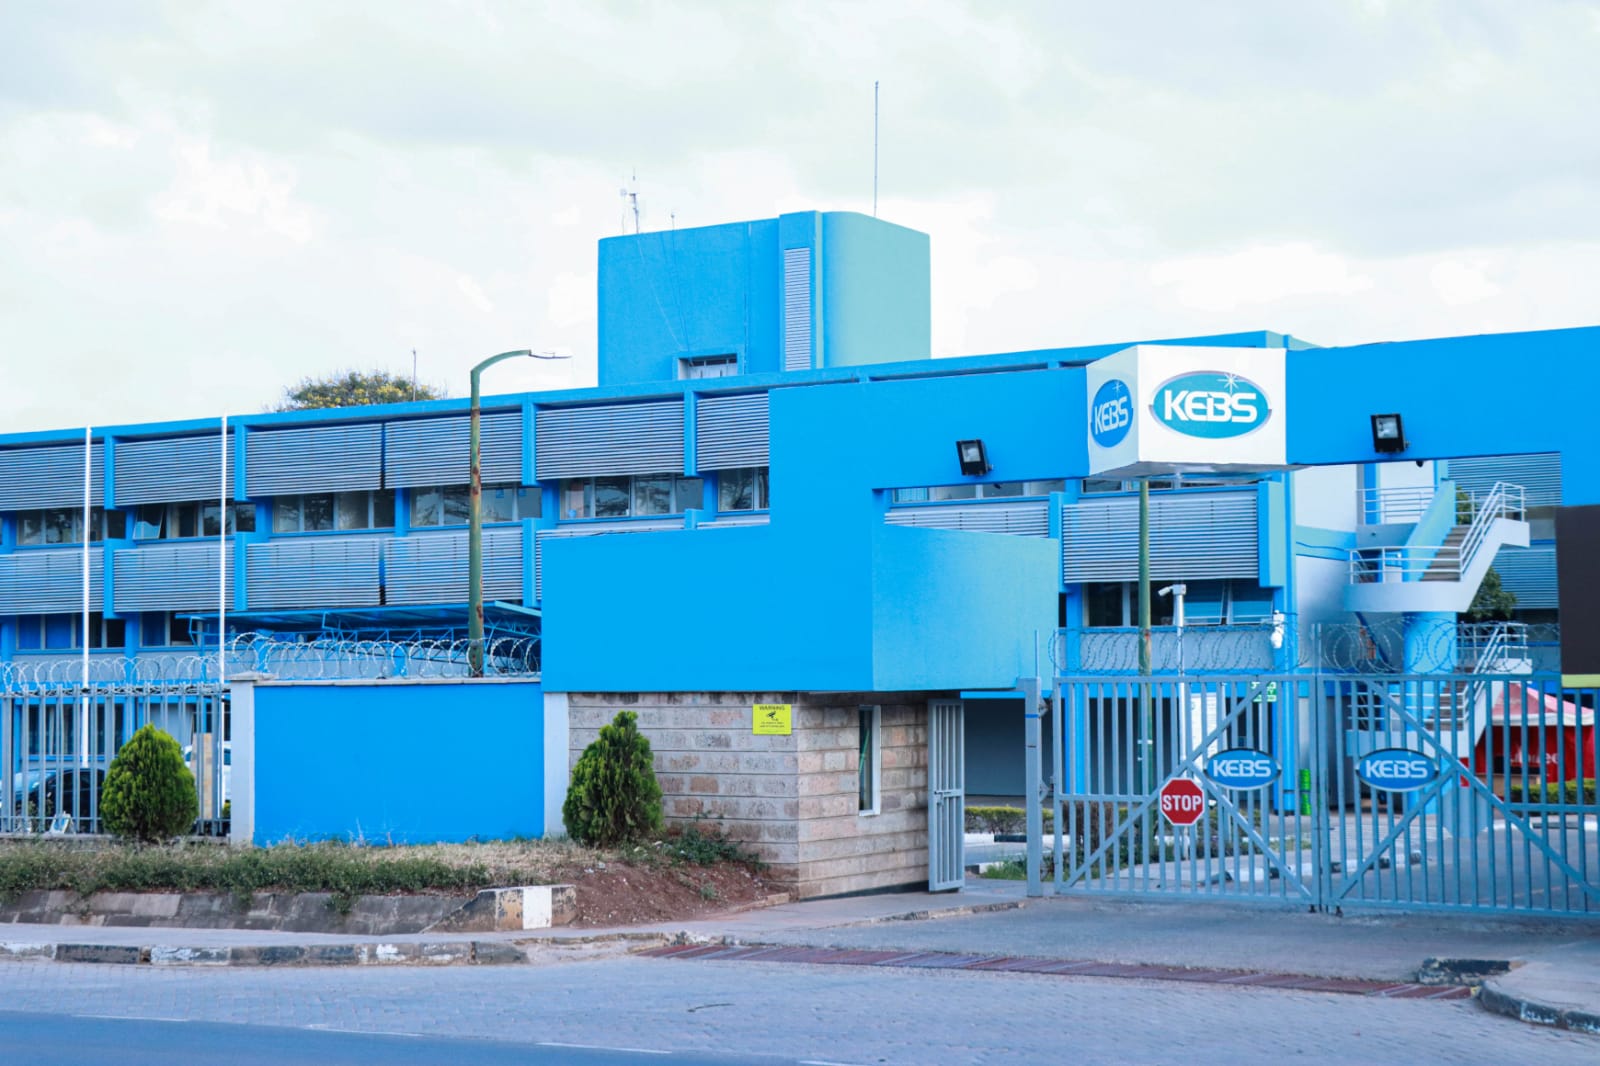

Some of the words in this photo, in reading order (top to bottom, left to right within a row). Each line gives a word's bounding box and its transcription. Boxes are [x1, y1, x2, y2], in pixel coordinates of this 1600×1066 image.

[1164, 389, 1258, 423] KEBS
[1094, 396, 1128, 435] KEBS
[1213, 759, 1271, 777] KEBS
[1365, 760, 1428, 778] KEBS
[1162, 794, 1202, 811] STOP
